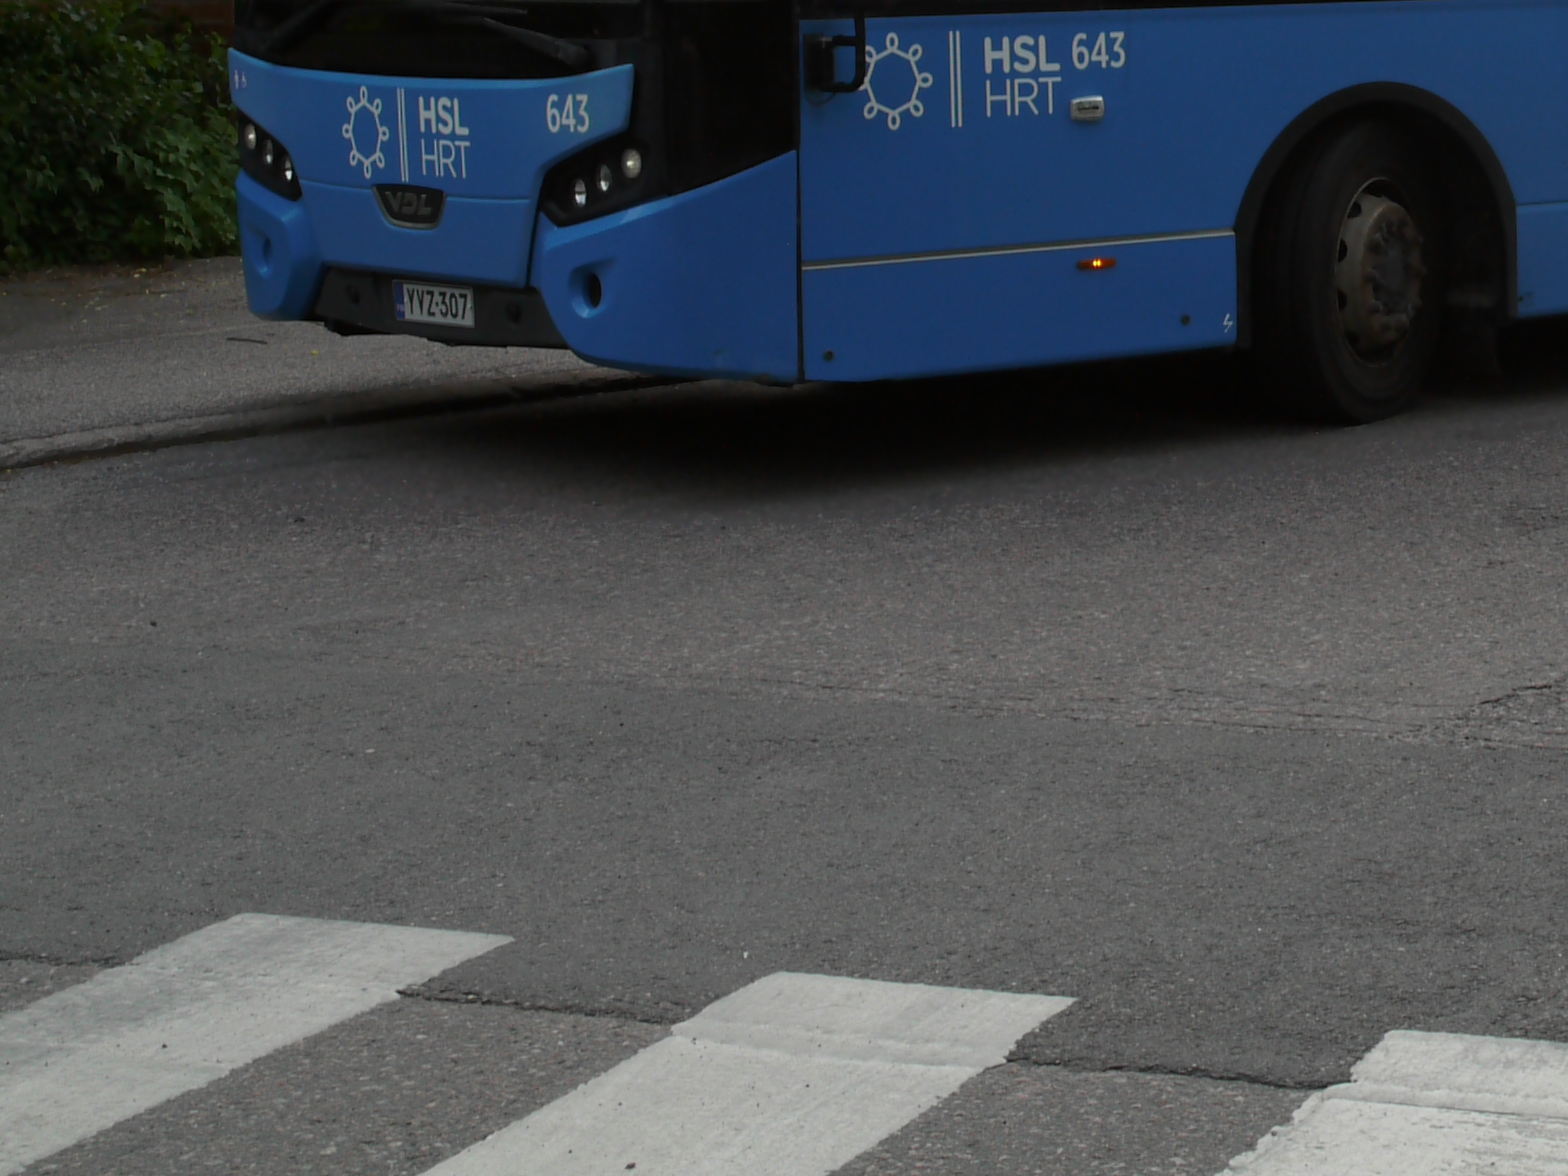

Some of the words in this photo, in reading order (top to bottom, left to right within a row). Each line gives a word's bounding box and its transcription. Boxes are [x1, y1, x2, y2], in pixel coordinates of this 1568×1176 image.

[984, 34, 1061, 74] HSL
[1071, 31, 1126, 70] 643
[418, 95, 470, 136] HSL
[545, 93, 590, 134] 643
[985, 76, 1062, 118] HRT
[420, 138, 471, 179] HRT
[384, 191, 432, 215] VDL
